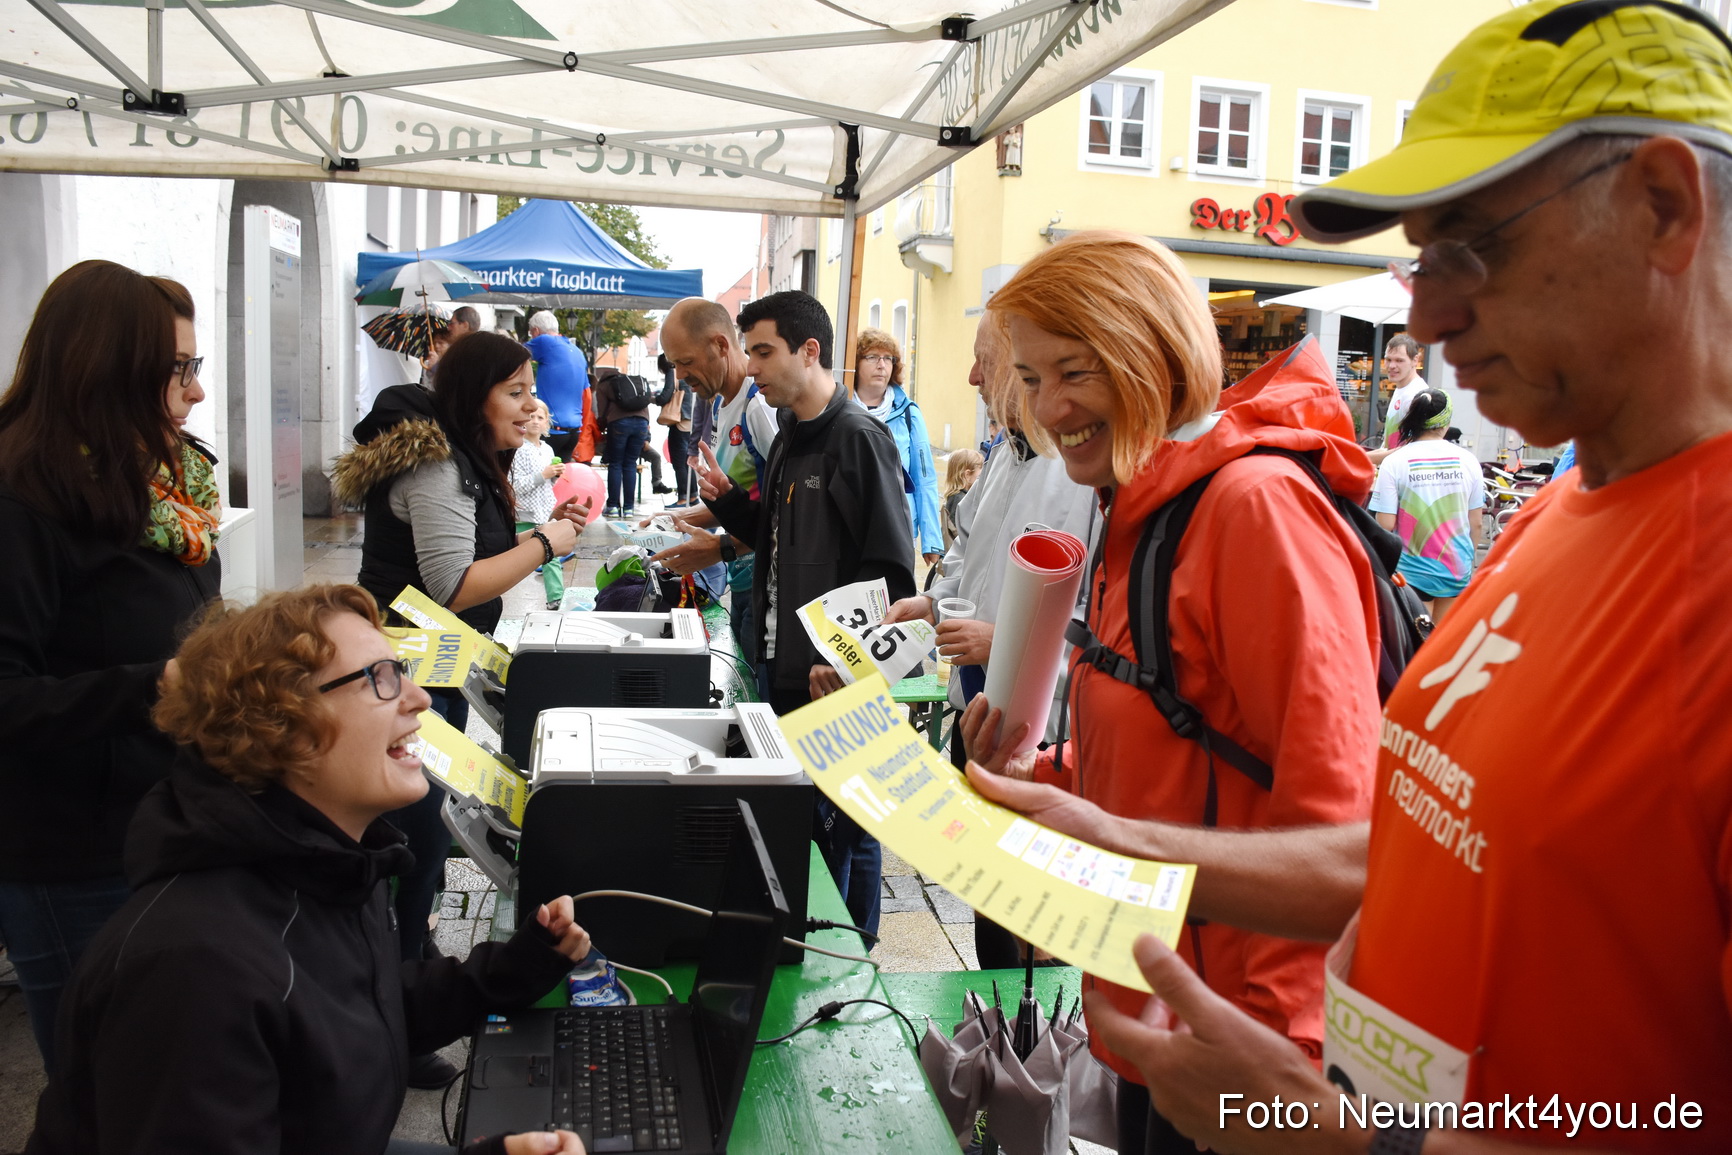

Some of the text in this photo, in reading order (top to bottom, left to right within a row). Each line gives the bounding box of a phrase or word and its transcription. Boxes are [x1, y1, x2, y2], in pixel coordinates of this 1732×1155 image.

[1190, 197, 1251, 232] Der
[548, 267, 625, 293] Tagblatt
[1408, 471, 1464, 482] NeuerMarkt
[425, 634, 462, 684] URKUNDE
[827, 633, 863, 667] Peter
[797, 694, 900, 771] URKUNDE
[839, 740, 925, 823] 17. Neumarkter
[887, 761, 940, 804] Stadtlauf
[1388, 769, 1488, 874] neumarkt
